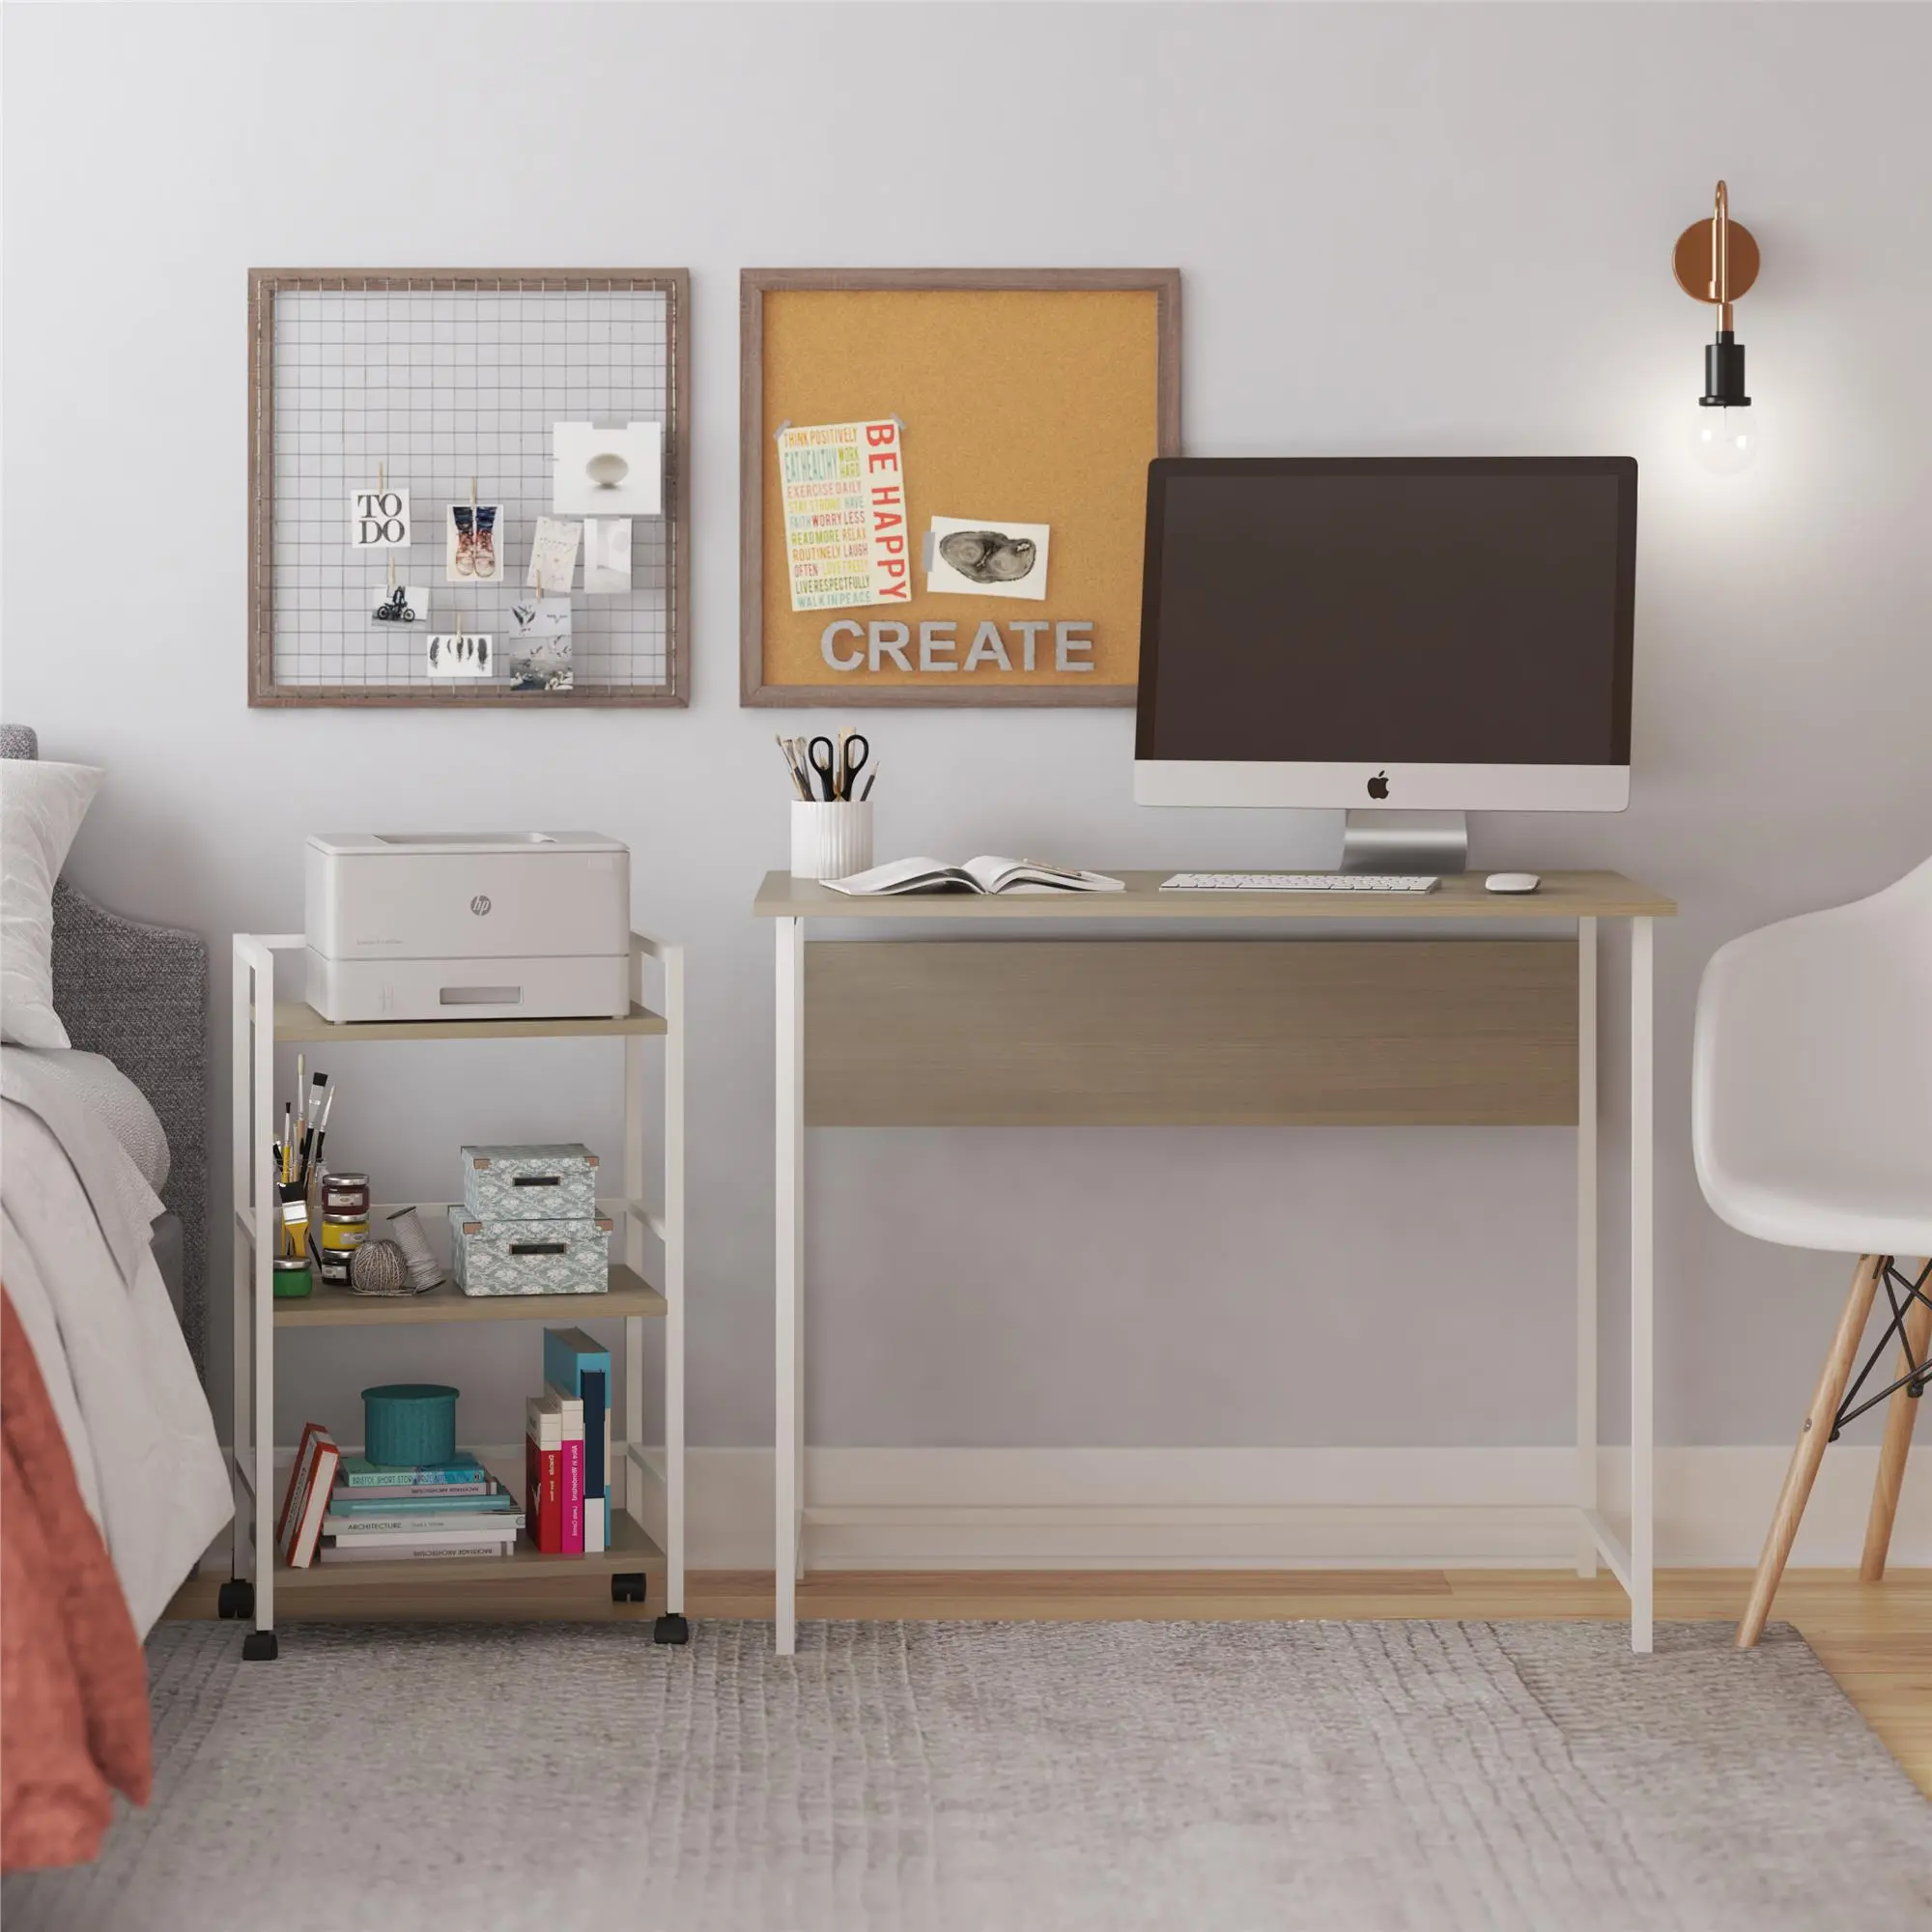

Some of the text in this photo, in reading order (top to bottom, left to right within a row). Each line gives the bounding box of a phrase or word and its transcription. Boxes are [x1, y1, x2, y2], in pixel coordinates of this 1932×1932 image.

[810, 426, 859, 445] POSITIVELY
[787, 480, 862, 498] EXERCISE DAILY
[357, 493, 403, 519] TO
[866, 424, 907, 599] BE HAPPY
[812, 512, 841, 527] WORRY
[843, 510, 866, 525] LESS
[358, 518, 406, 544] DO
[792, 526, 867, 546] READ MORE RELAX
[792, 542, 868, 561] ROUTINELY LAUGH
[794, 563, 819, 578] OFTEN
[795, 574, 869, 595] LIVE RESPECTFULLY
[797, 590, 870, 608] WALK IN PEACE
[821, 619, 1094, 672] CREATE
[470, 895, 491, 916] hp
[377, 1475, 395, 1485] SHORT
